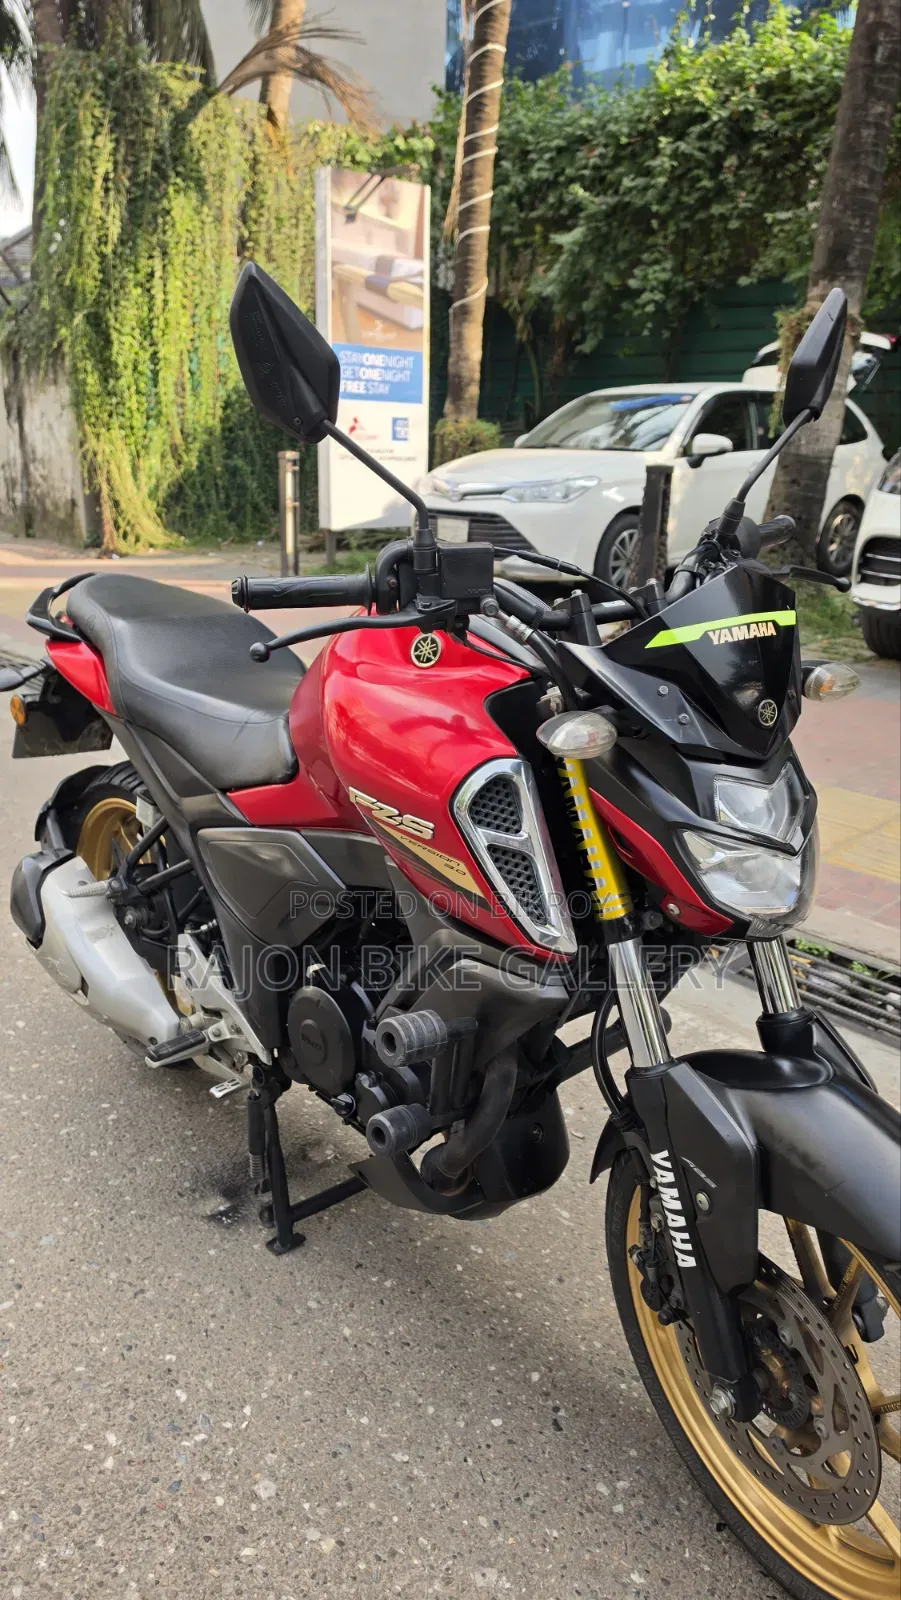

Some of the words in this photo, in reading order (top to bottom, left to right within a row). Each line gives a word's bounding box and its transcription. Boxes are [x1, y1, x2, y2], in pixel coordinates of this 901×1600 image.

[340, 380, 367, 393] FREE
[368, 383, 391, 395] STAY
[707, 621, 777, 646] YAMAHA
[556, 756, 607, 893] AMAHA
[650, 1149, 697, 1268] YAMAHA
